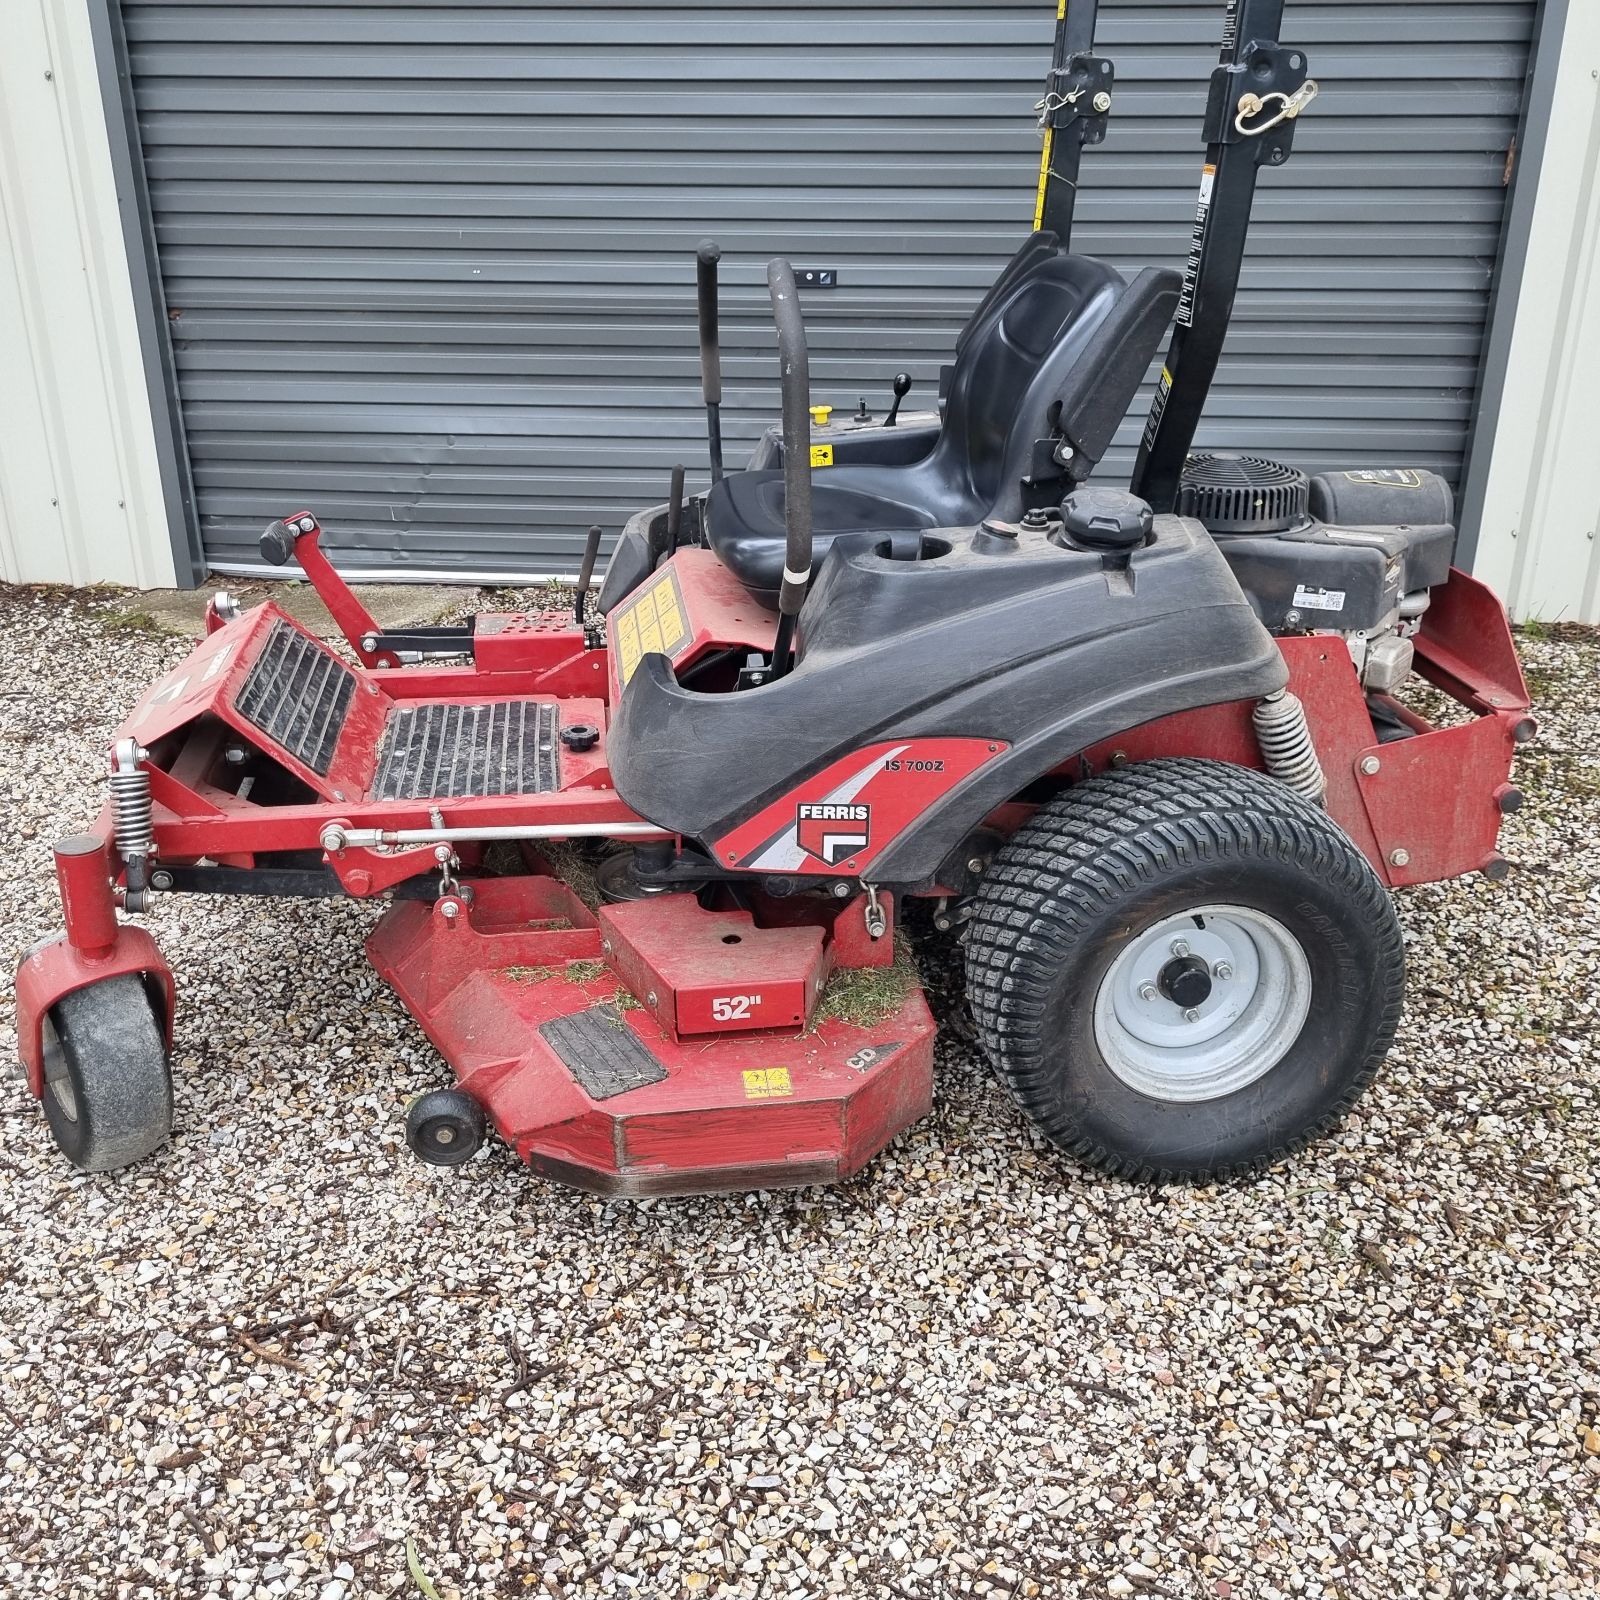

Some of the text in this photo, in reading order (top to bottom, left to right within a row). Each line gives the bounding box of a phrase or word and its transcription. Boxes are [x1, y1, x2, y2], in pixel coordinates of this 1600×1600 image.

[885, 760, 944, 772] IS 700Z
[799, 805, 868, 820] FERRIS
[712, 995, 762, 1021] 52"
